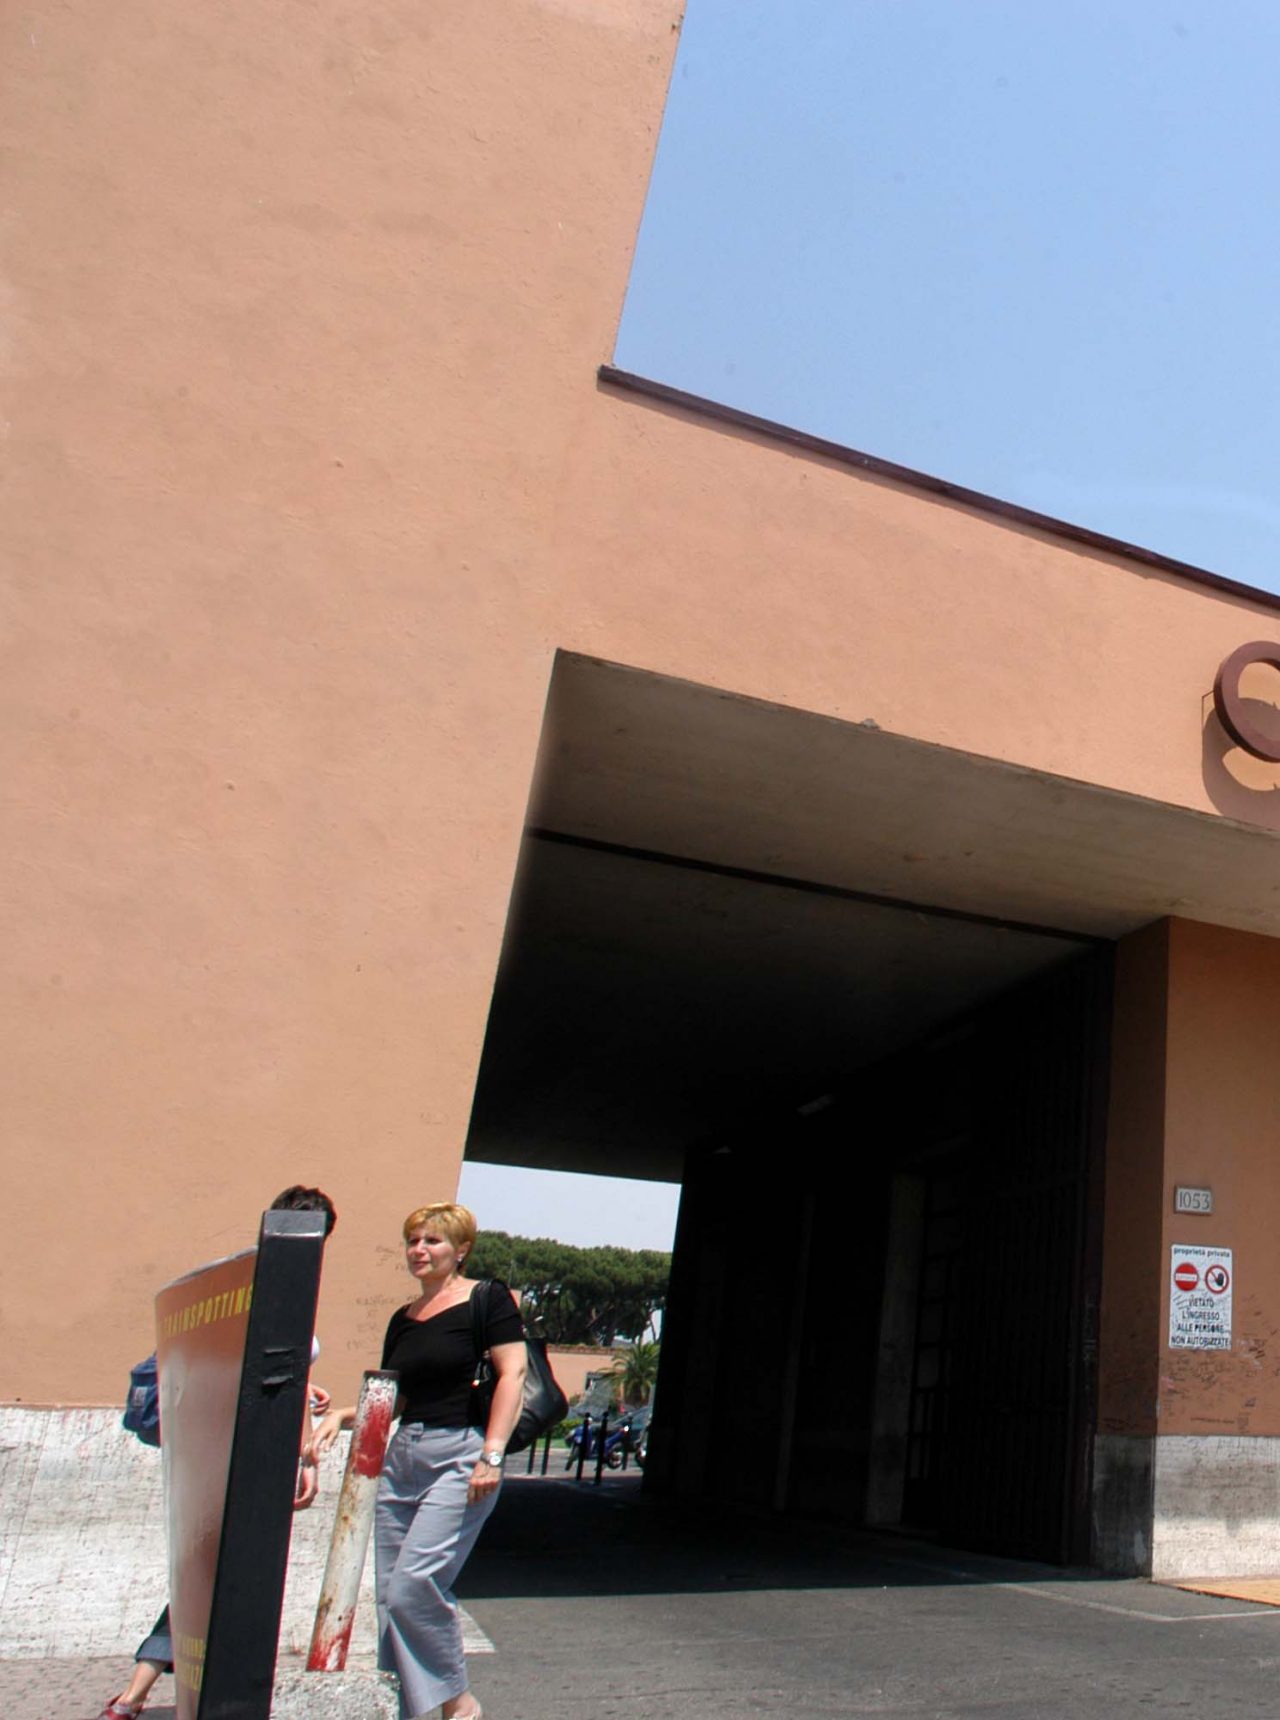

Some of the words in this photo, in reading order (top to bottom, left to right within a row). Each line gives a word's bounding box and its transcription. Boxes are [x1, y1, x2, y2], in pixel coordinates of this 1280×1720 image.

[1179, 1191, 1210, 1210] 1053
[1188, 1297, 1215, 1308] VIETATO
[1182, 1310, 1220, 1321] L'INGRESSO
[1176, 1322, 1193, 1333] ALLE
[1171, 1335, 1186, 1346] NON
